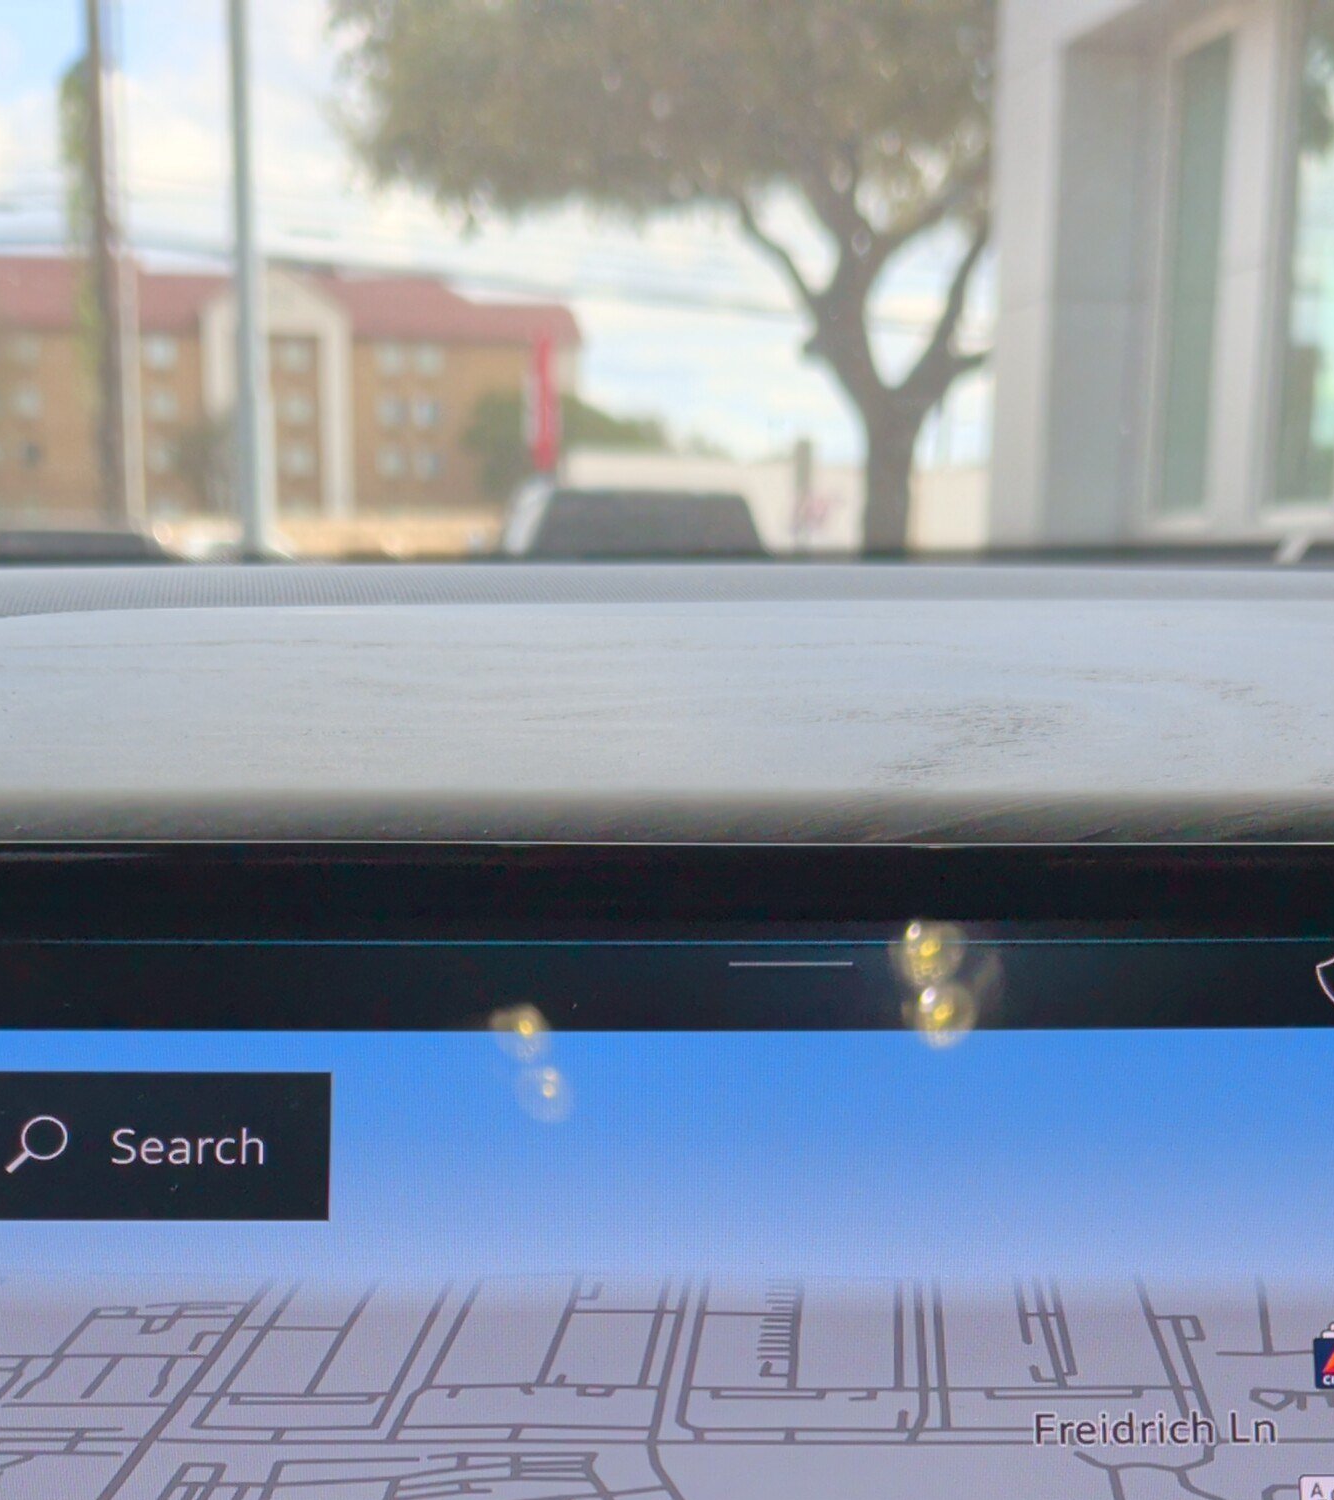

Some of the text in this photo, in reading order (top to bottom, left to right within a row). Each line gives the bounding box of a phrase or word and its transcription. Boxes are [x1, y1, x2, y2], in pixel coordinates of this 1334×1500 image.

[110, 1126, 266, 1167] Search
[1034, 1410, 1277, 1445] Freidrich Ln
